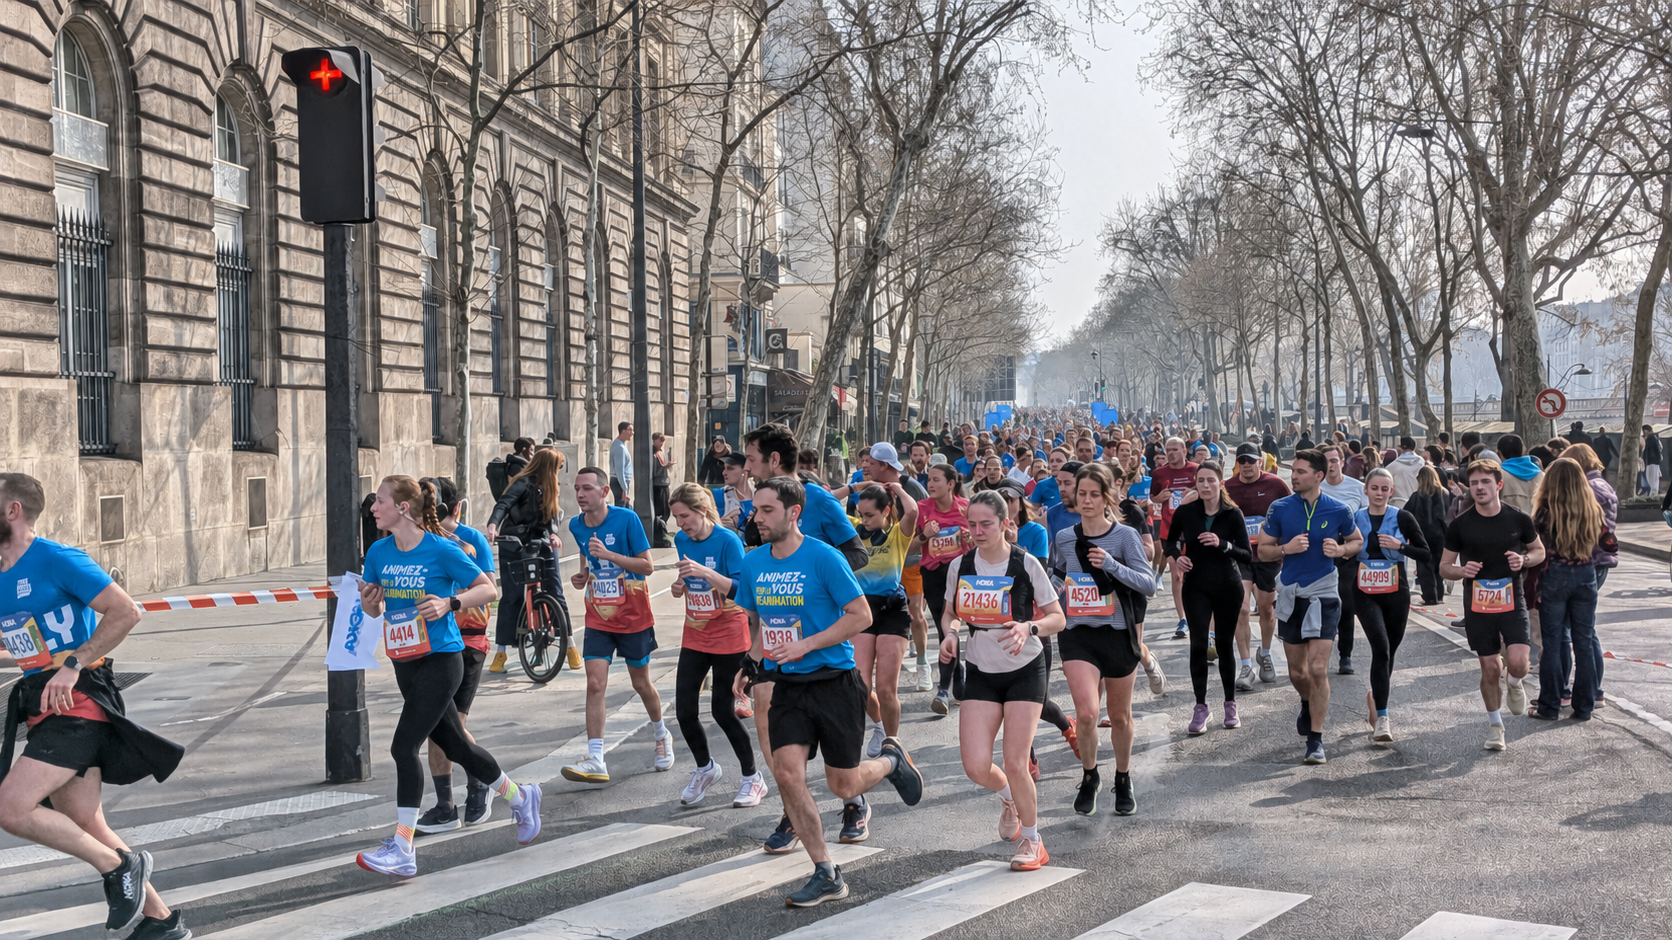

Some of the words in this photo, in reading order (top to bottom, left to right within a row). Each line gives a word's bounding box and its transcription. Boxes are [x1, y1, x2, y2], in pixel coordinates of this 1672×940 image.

[381, 564, 428, 576] ANIMEZ-
[395, 576, 426, 588] VOUS
[756, 571, 806, 583] ANIMEZ-
[1361, 570, 1389, 583] 44909
[772, 583, 804, 595] VOUS
[963, 591, 998, 609] 21436
[390, 624, 414, 643] 4414
[765, 629, 793, 645] 1938
